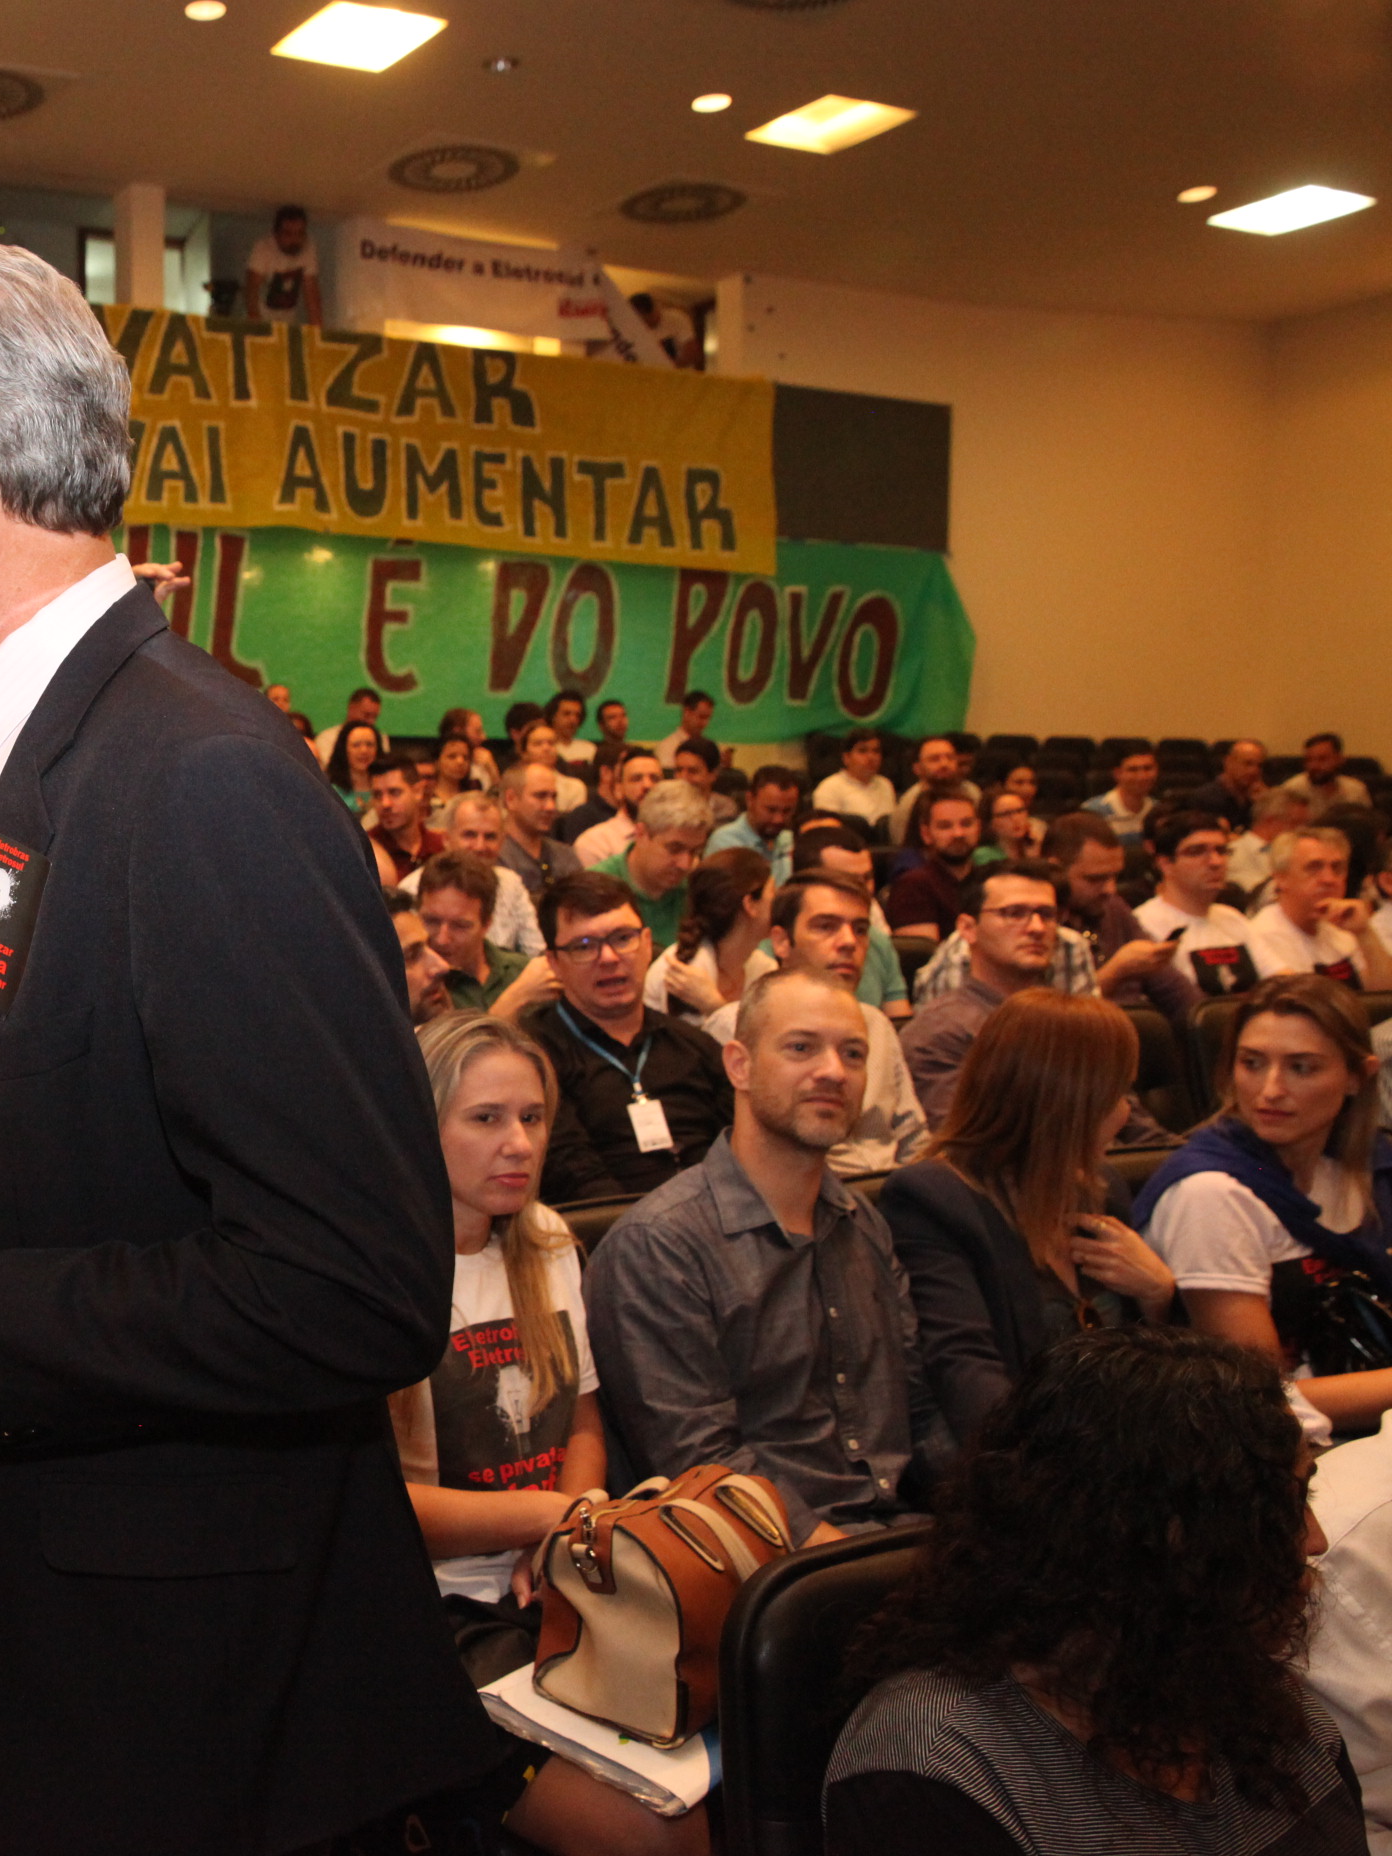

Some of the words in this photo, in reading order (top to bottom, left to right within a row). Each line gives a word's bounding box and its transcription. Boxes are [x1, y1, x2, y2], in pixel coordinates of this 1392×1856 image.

[360, 239, 465, 273] Defender
[276, 422, 738, 554] AUMENTAR
[487, 558, 619, 700] DO
[663, 566, 901, 720] POVO
